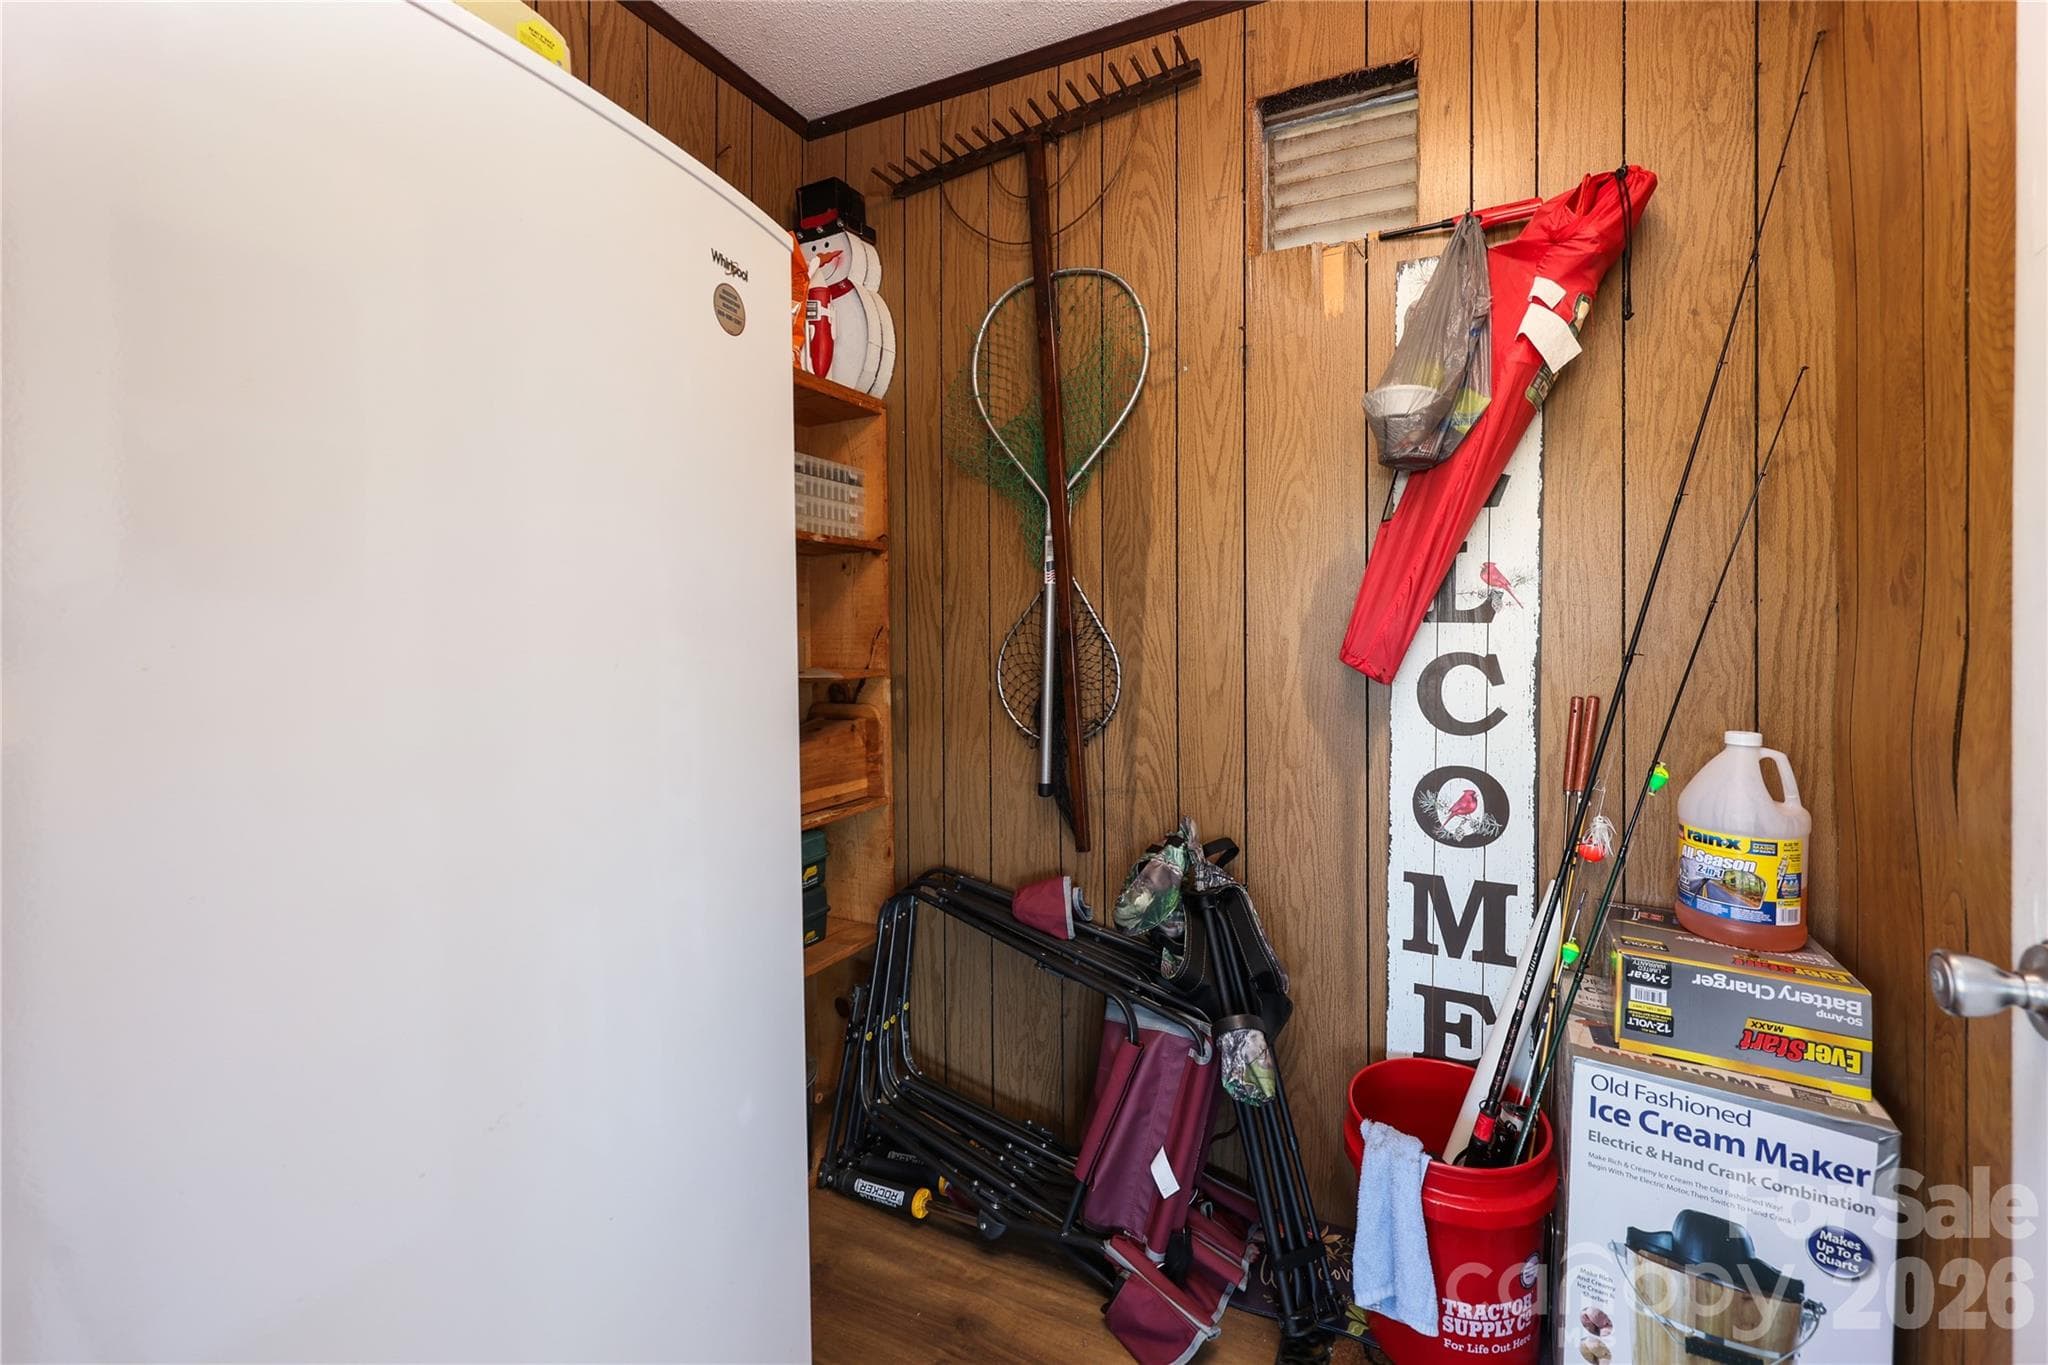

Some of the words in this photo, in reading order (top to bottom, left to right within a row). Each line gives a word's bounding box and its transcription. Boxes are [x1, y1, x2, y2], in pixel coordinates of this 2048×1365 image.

[711, 248, 749, 282] Whirlpool
[1403, 473, 1519, 1067] LCOME
[1696, 849, 1757, 873] Season
[1627, 970, 1670, 985] 2-Year
[1691, 973, 1775, 1000] Charger
[1777, 985, 1863, 1016] Battery
[1627, 1017, 1672, 1034] 12-VOLT
[1750, 1020, 1784, 1033] MAXX
[1816, 1010, 1864, 1027] 50-Amp
[1738, 1028, 1863, 1076] EverStart
[1591, 1074, 1628, 1098] Old
[1635, 1084, 1752, 1128] Fashioned
[1590, 1095, 1631, 1127] Ice
[1639, 1110, 1746, 1157] Cream
[1755, 1137, 1872, 1187] Maker
[1588, 1152, 1606, 1162] Make
[1694, 1181, 1709, 1190] The
[1588, 1129, 1642, 1155] Electric
[1646, 1146, 1658, 1160] &
[1661, 1149, 1704, 1171] Hand
[1708, 1163, 1757, 1186] Crank
[1761, 1176, 1876, 1217] Combination
[1588, 1161, 1607, 1172] Begin
[1608, 1166, 1624, 1177] With
[1625, 1172, 1638, 1180] The
[1640, 1176, 1665, 1188] Electric
[860, 1183, 899, 1201] ROCKER
[1816, 1240, 1835, 1256] Up
[1836, 1246, 1851, 1259] To
[1853, 1250, 1863, 1262] 6
[1819, 1230, 1862, 1250] Makes
[1815, 1251, 1860, 1274] Quarts
[1442, 1293, 1532, 1322] TRACTOR
[1442, 1317, 1515, 1338] SUPPLY
[1443, 1338, 1464, 1351] For
[1467, 1343, 1489, 1355] Life
[1491, 1343, 1511, 1354] Out
[1513, 1334, 1532, 1350] Here
